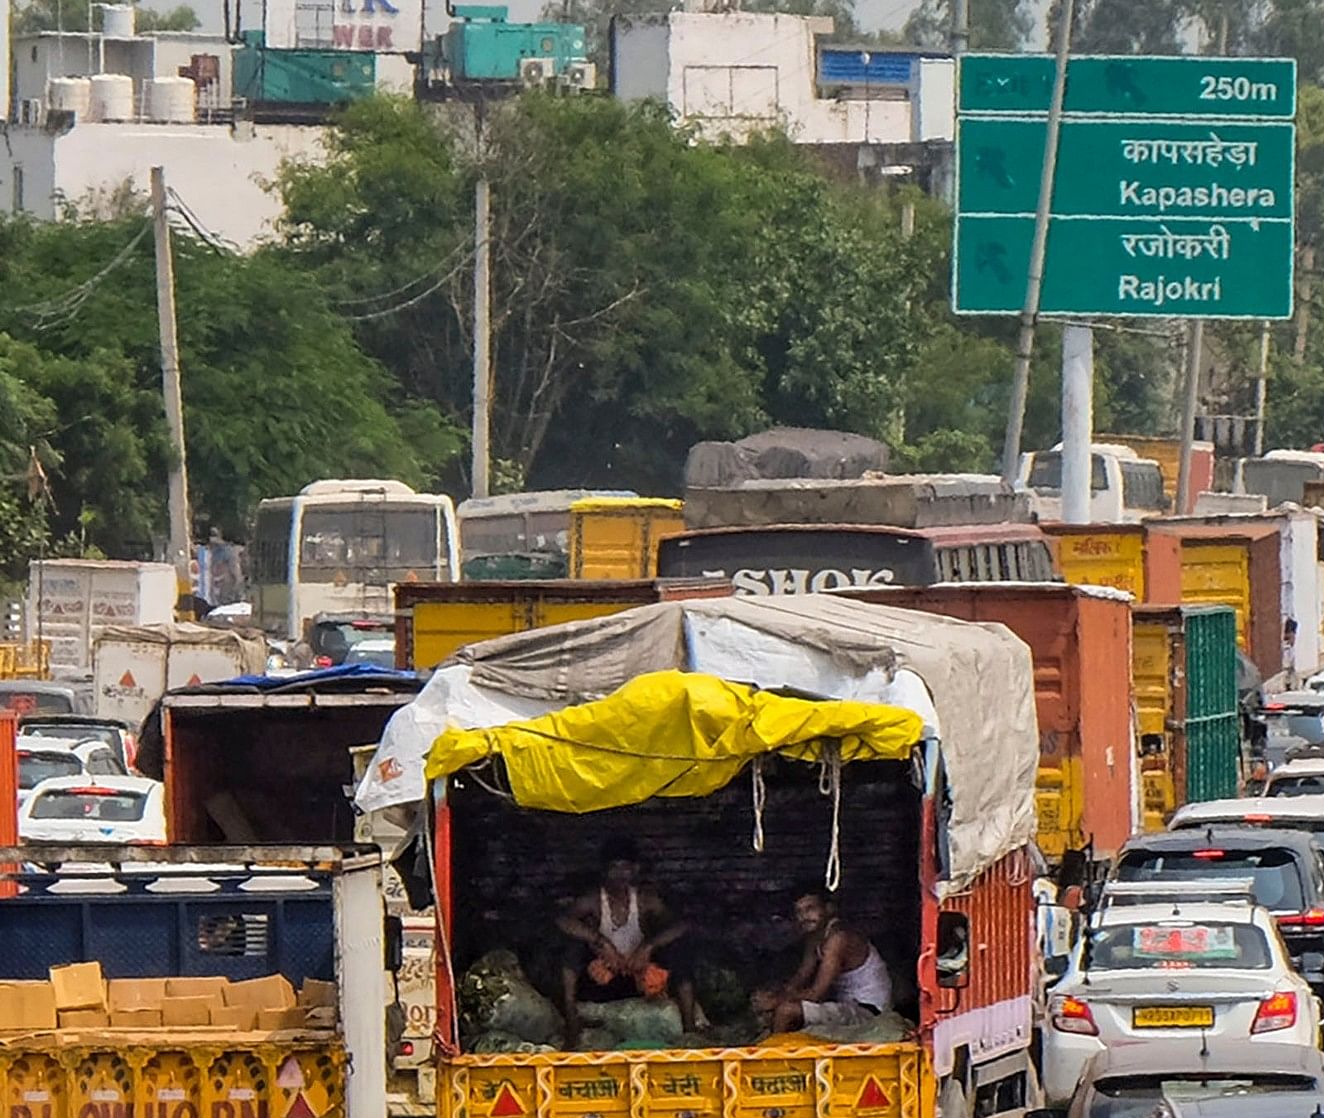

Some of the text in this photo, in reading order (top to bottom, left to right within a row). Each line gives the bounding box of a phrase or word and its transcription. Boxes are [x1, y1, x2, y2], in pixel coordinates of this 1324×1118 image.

[1200, 76, 1277, 100] 250m
[1121, 132, 1257, 170] कापसहेड़ा
[1120, 181, 1275, 211] Kapashera
[1121, 225, 1230, 259] रजोकरी
[1119, 275, 1221, 305] Rajokri
